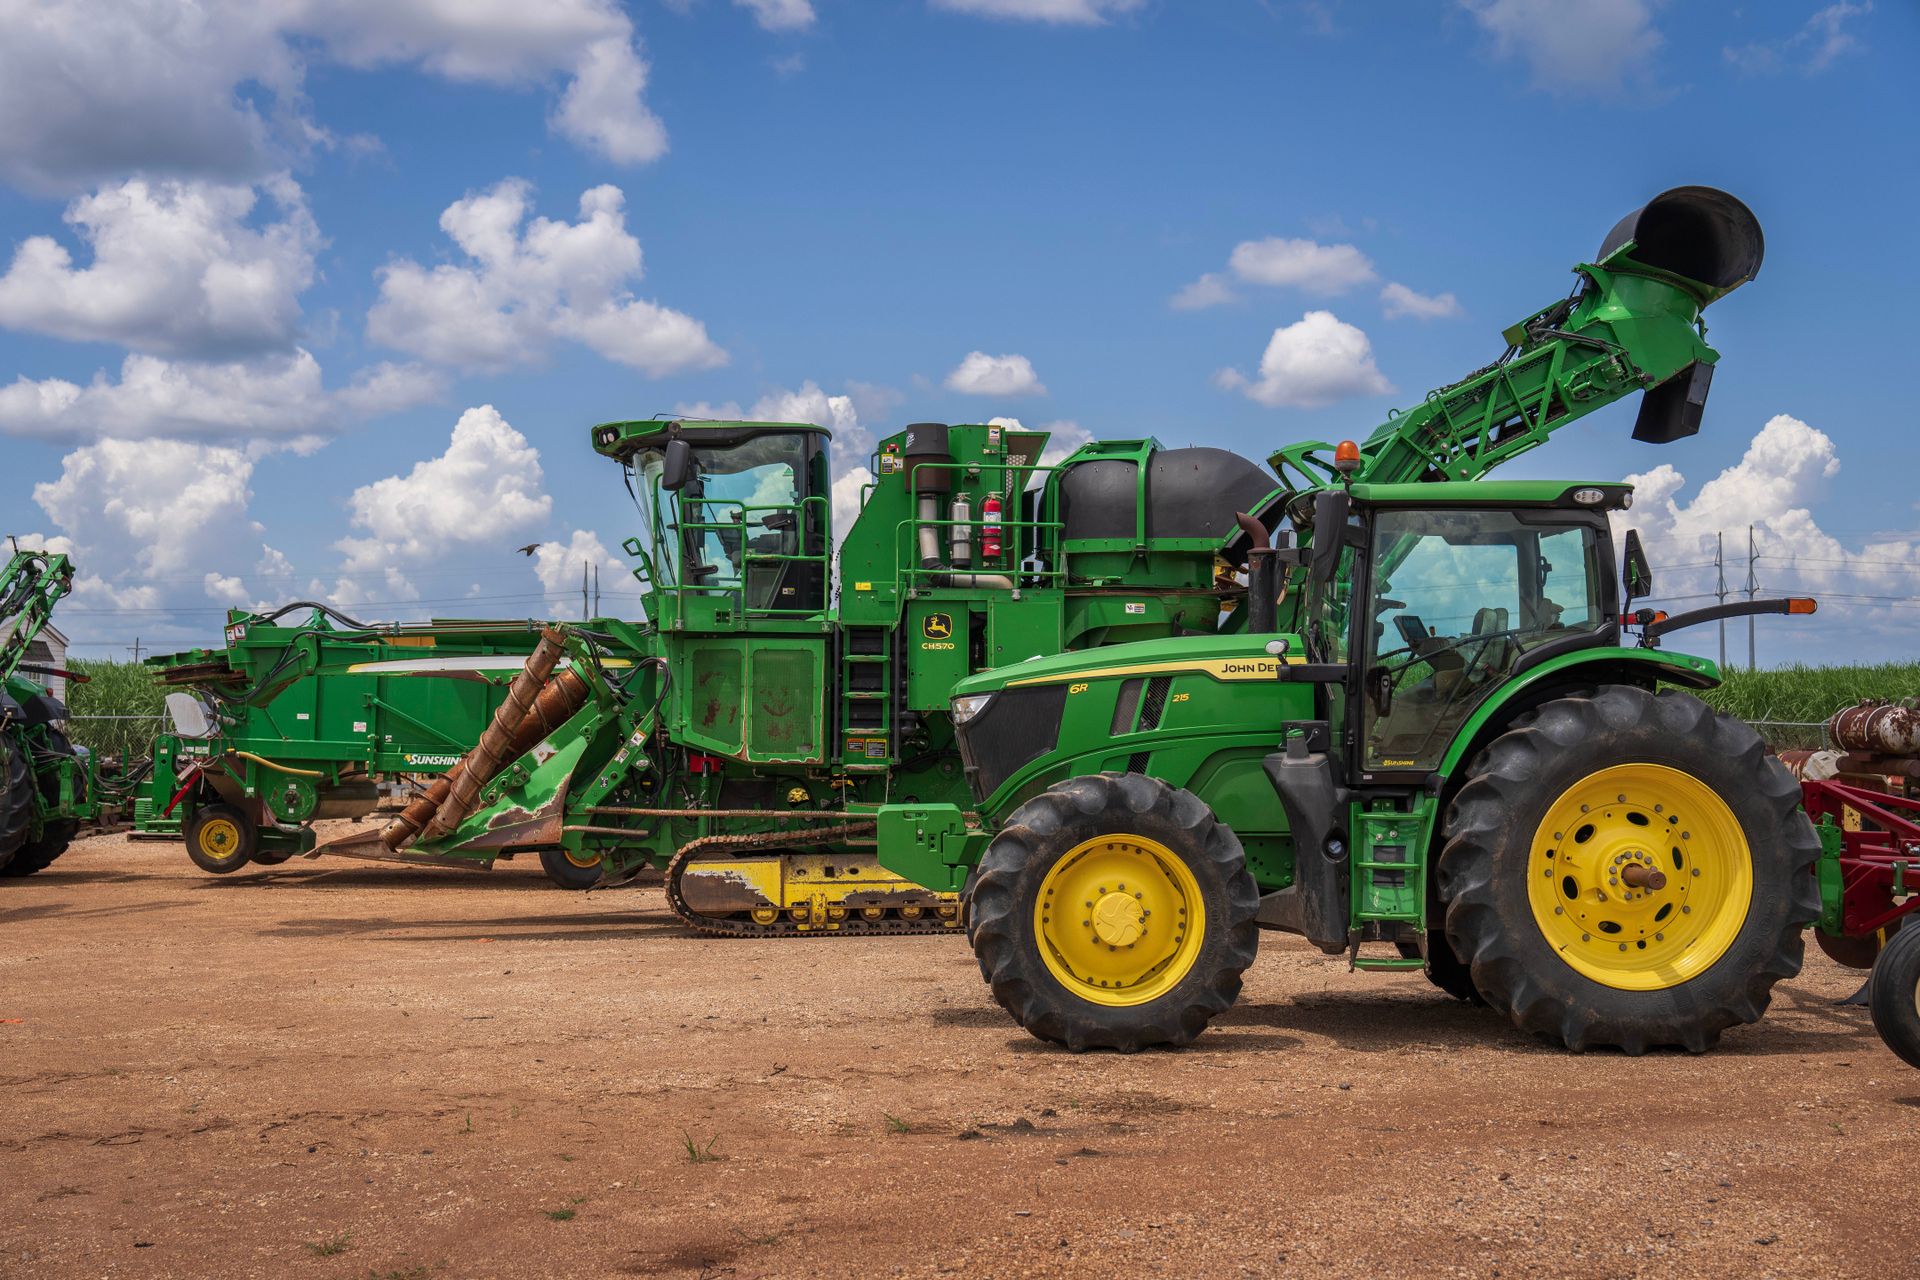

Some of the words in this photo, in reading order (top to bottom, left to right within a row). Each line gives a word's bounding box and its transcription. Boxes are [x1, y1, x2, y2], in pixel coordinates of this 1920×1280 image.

[921, 642, 955, 650] CH570
[1221, 664, 1255, 673] JOHN
[1069, 683, 1089, 694] 6R
[1172, 693, 1190, 703] 215
[410, 754, 462, 765] SUNSHIN
